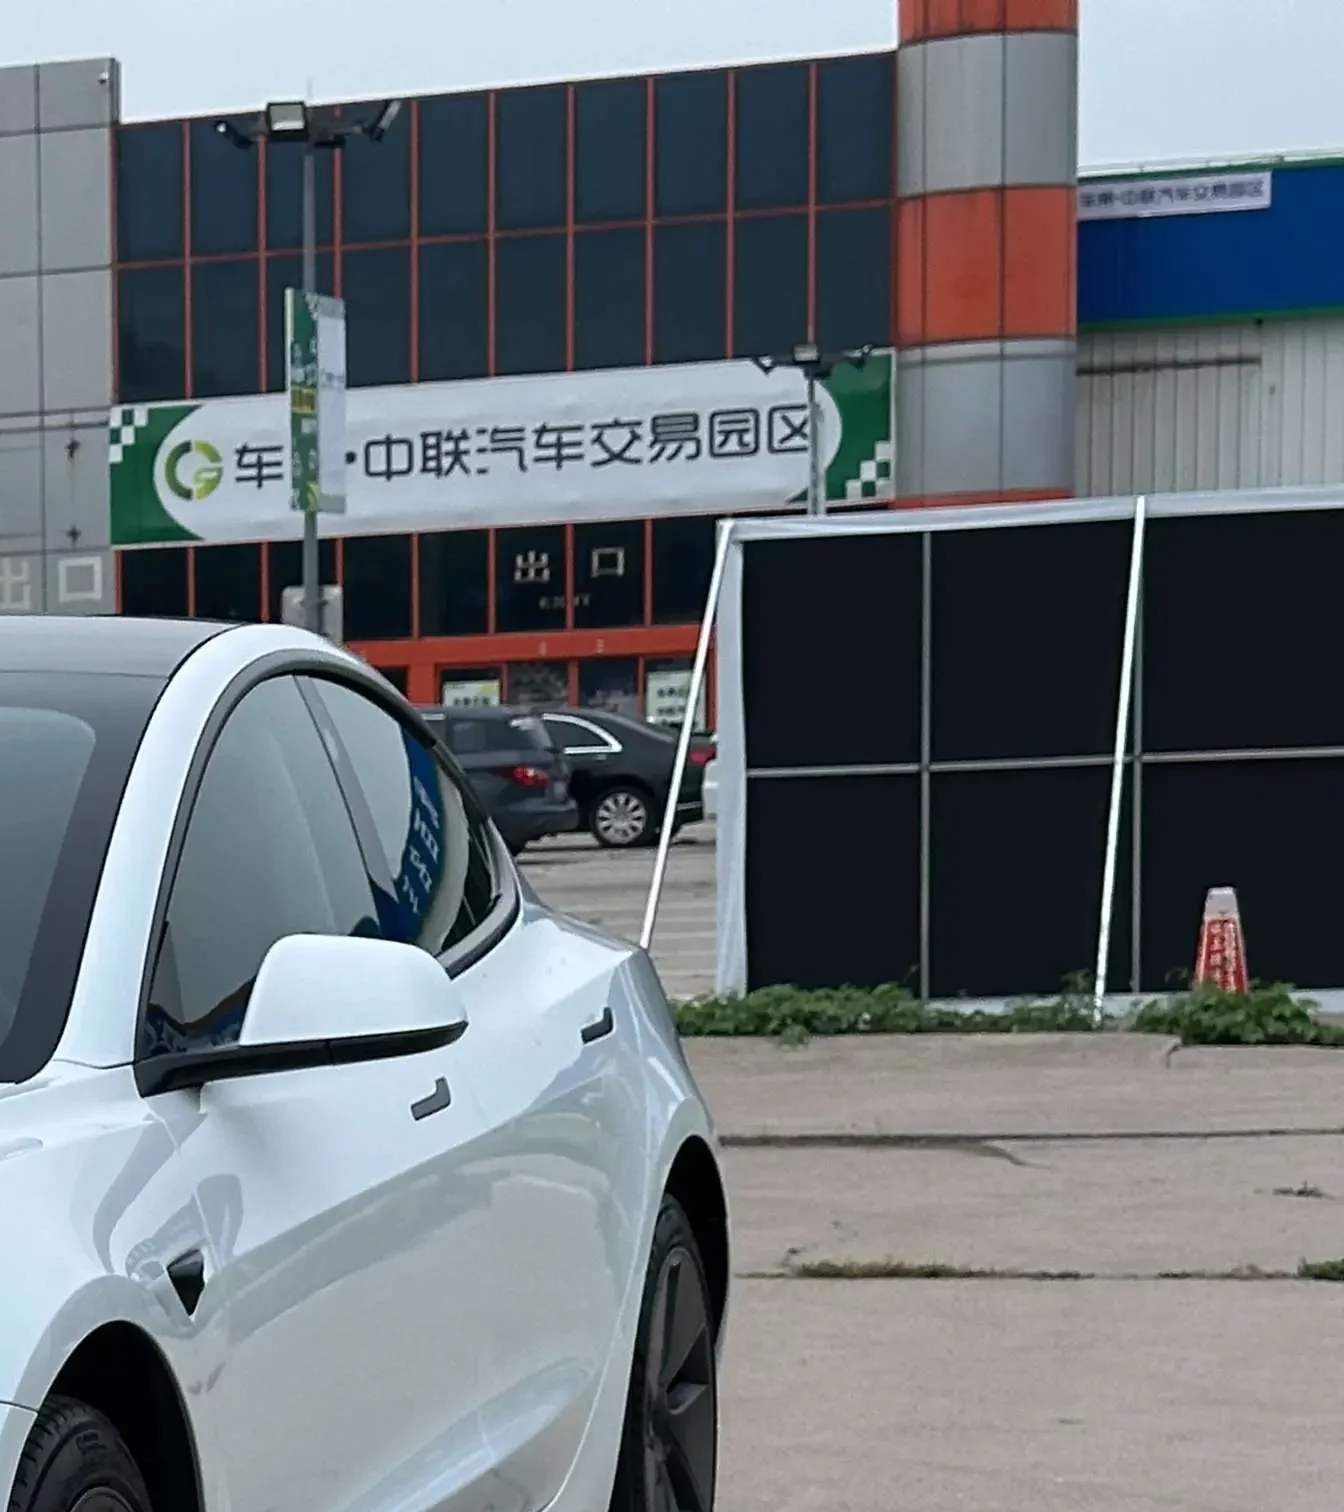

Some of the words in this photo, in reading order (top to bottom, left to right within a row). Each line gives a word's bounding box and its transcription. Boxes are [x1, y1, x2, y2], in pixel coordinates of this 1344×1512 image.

[235, 404, 810, 489] 车·中联汽车交易园区
[515, 547, 624, 583] 出口
